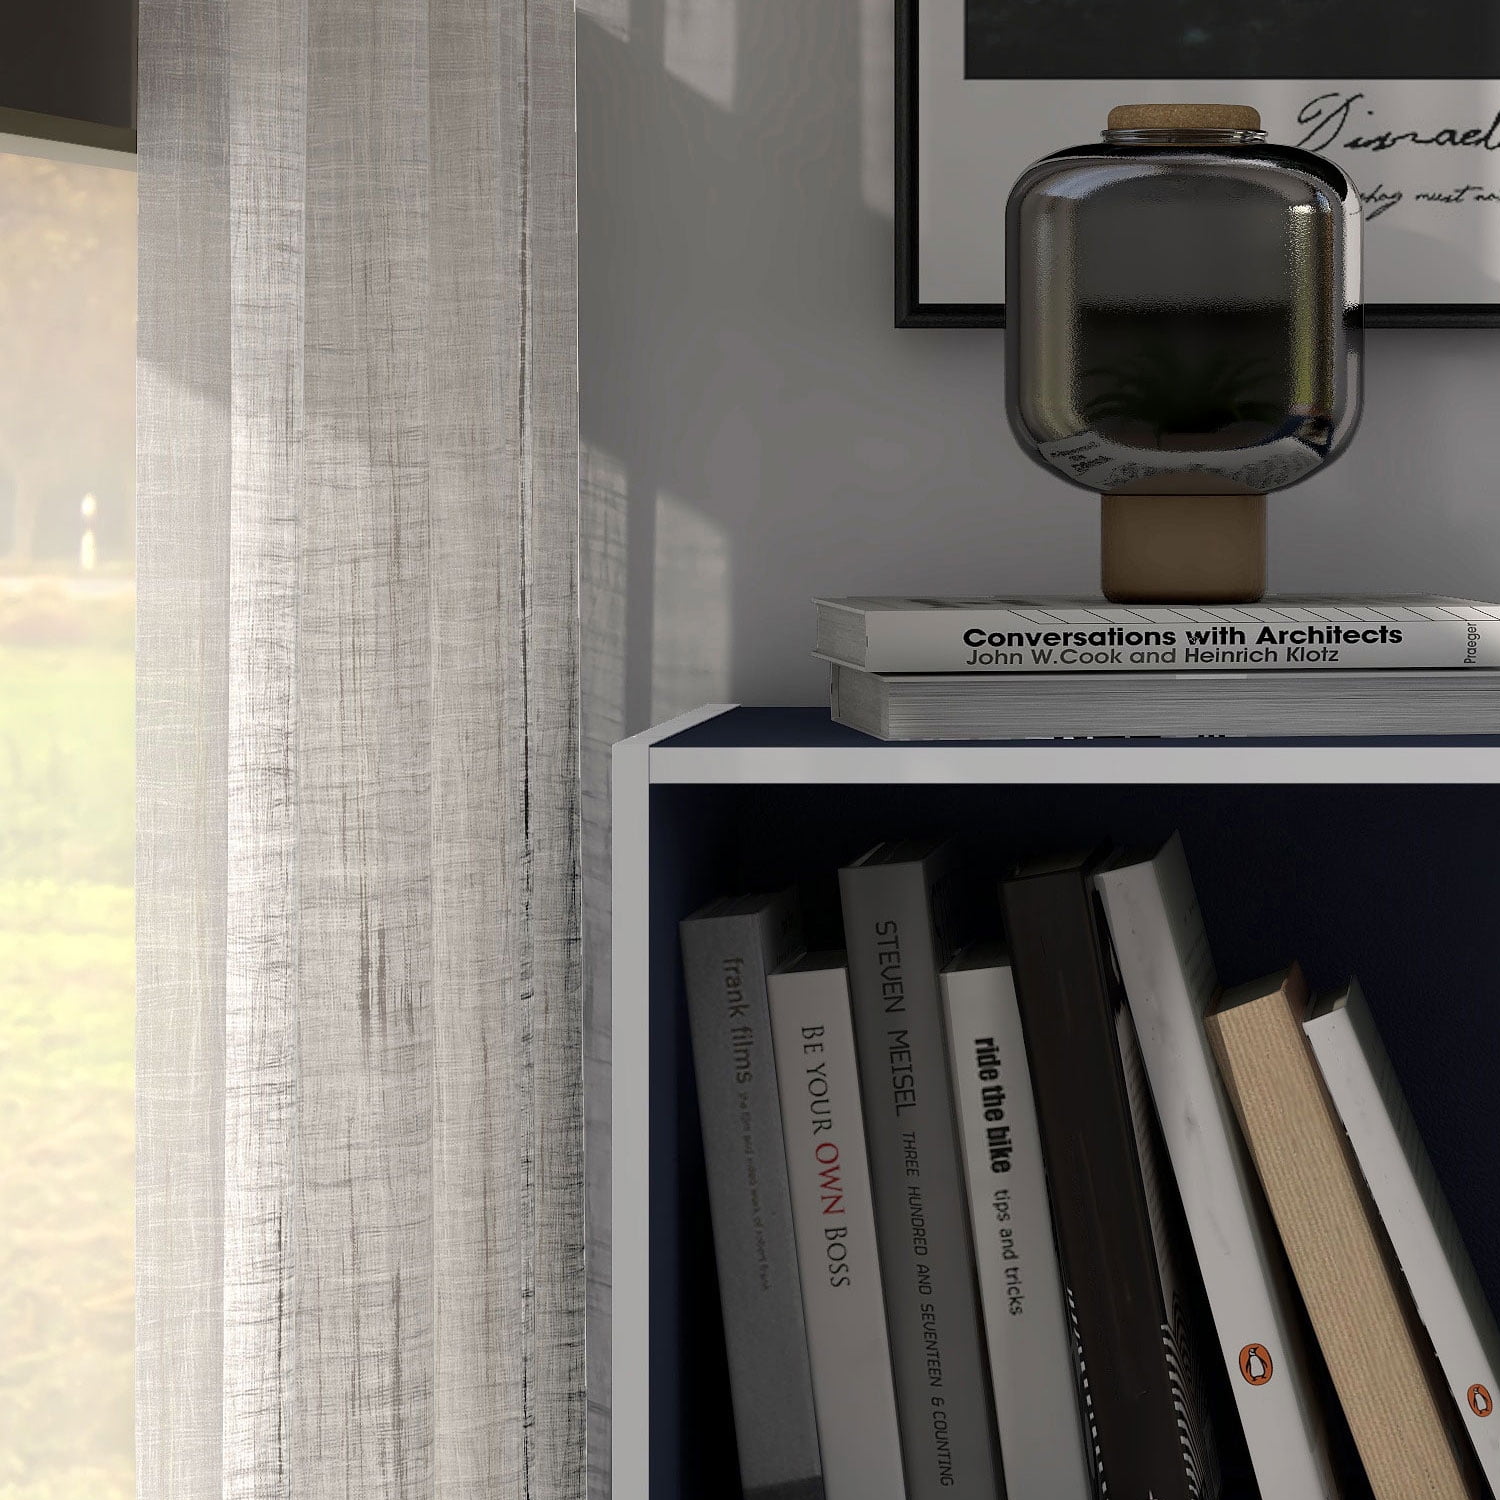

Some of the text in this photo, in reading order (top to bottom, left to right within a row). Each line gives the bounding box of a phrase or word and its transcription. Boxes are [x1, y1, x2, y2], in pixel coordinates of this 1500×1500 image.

[963, 624, 1403, 647] Conversations with Architects
[966, 648, 1023, 665] John
[1129, 647, 1176, 664] and
[1184, 646, 1278, 663] Heinrich
[1286, 646, 1340, 662] Klotz
[1463, 622, 1481, 664] Praeger
[721, 957, 750, 1018] frank
[875, 919, 906, 1014] STEVEN
[730, 1027, 754, 1084] films
[887, 1029, 917, 1117] MEISEL
[802, 1025, 851, 1287] BE YOUR OWN BOSS
[902, 1131, 920, 1177] THREE
[974, 1037, 1024, 1316] ride the bike tips and tricks
[906, 1186, 928, 1256] HUNDRED
[917, 1263, 932, 1295] AND
[921, 1303, 944, 1387] SEVENTEEN
[933, 1411, 954, 1487] COUNTING
